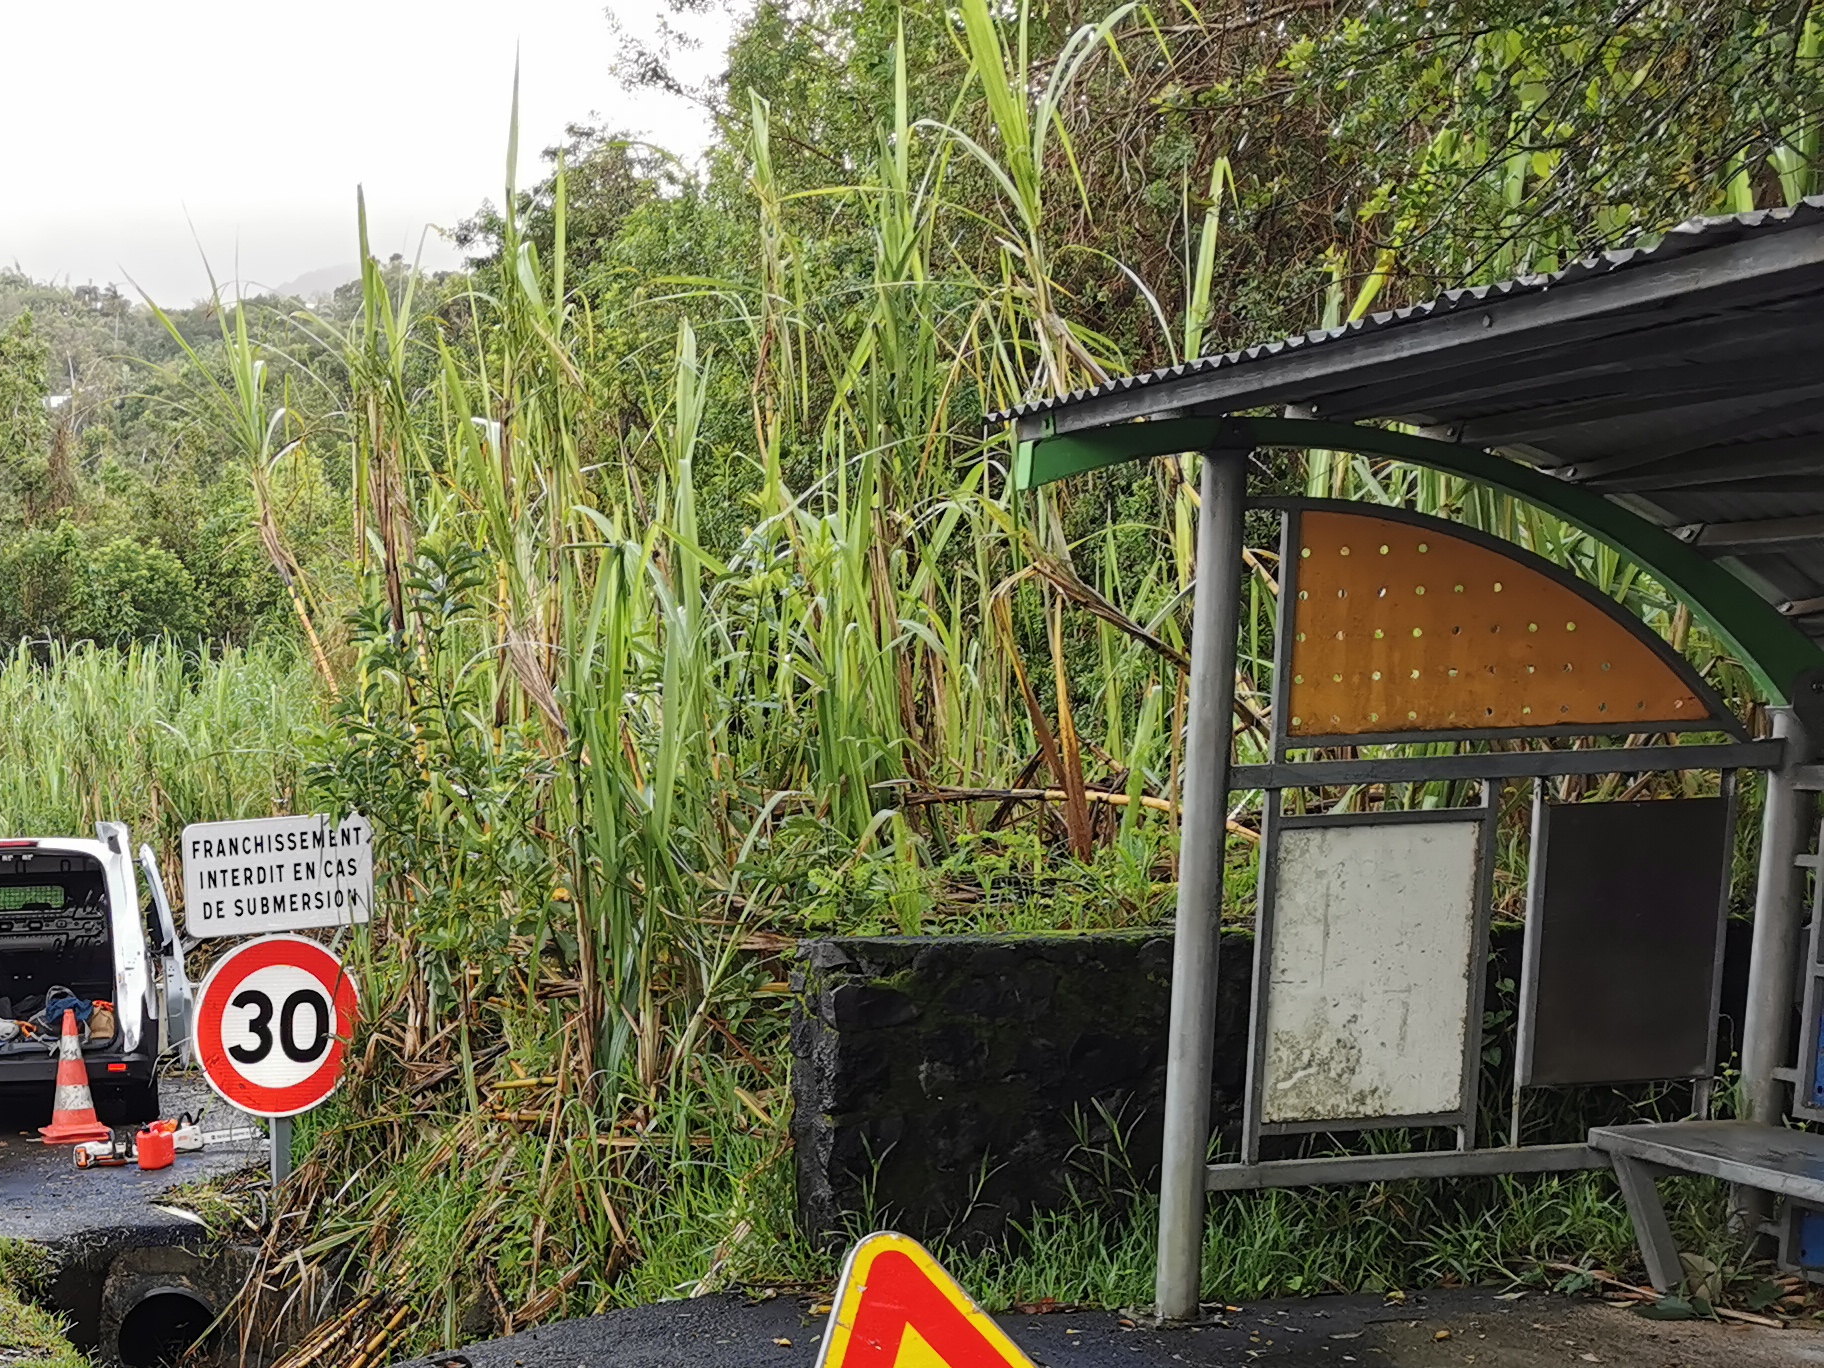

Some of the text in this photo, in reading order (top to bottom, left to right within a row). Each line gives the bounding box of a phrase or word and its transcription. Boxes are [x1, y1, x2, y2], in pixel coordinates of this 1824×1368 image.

[192, 827, 362, 859] FRANCHISSEMENT
[200, 858, 357, 889] INTERDIT EN CAS
[203, 889, 357, 920] DE SUBMERSION
[228, 989, 330, 1064] 30
